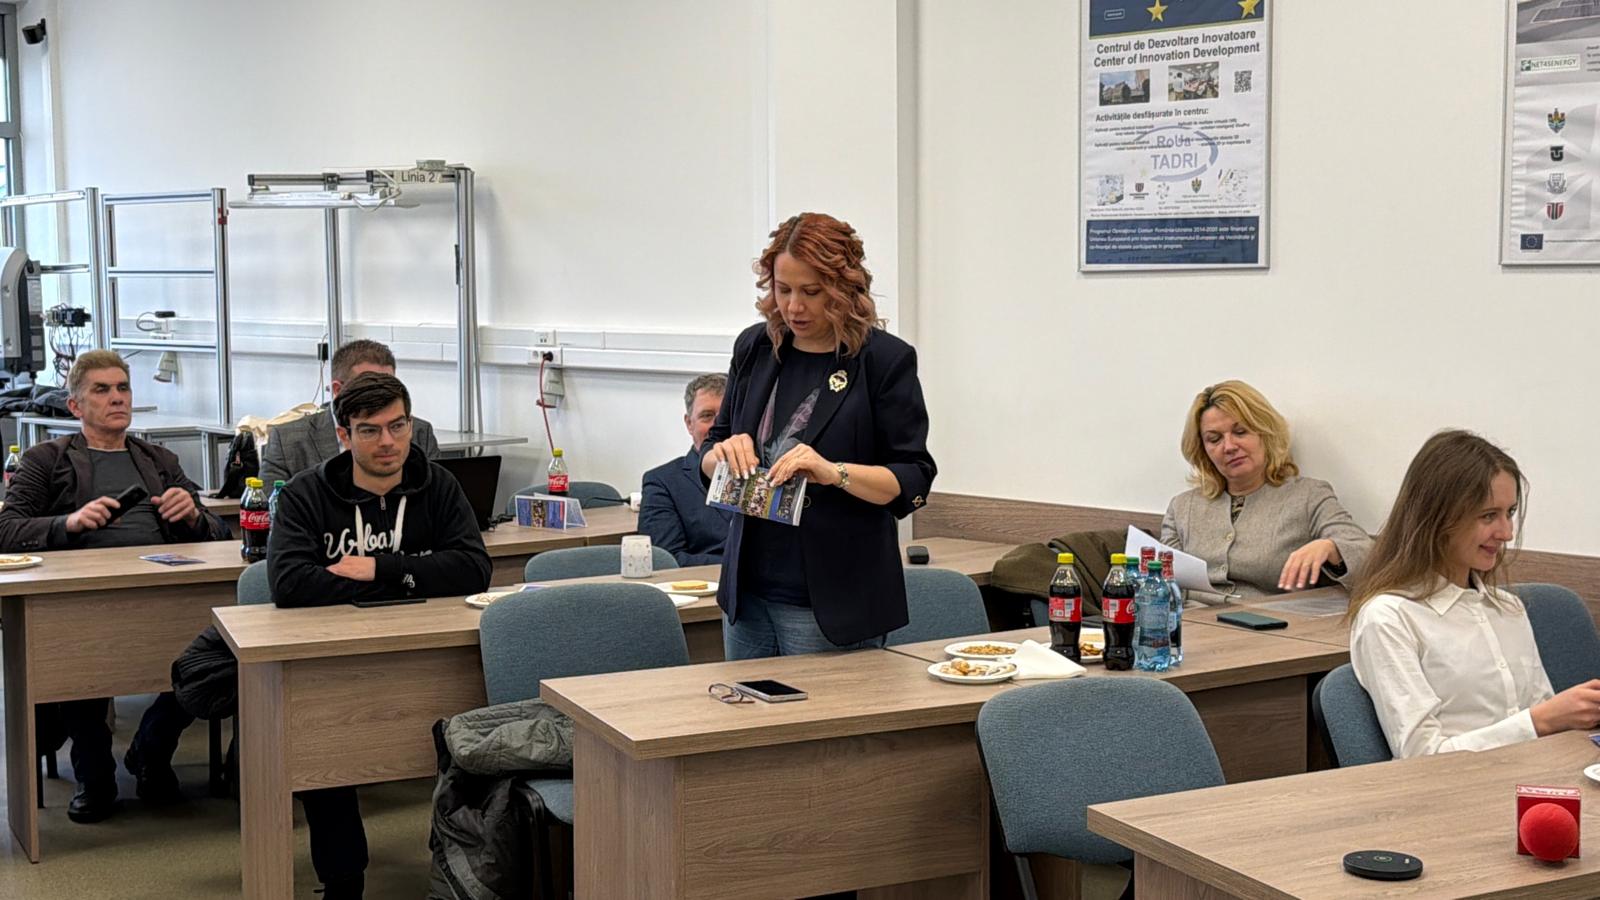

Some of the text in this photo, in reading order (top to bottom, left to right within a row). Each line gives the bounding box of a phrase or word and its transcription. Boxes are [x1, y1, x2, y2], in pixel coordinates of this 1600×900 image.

[1096, 29, 1256, 54] Centrul de Dezvoltare Inovatoare
[1094, 42, 1260, 68] Center of Innovation Development
[1150, 153, 1198, 170] TADRI
[402, 172, 435, 182] Linia 2
